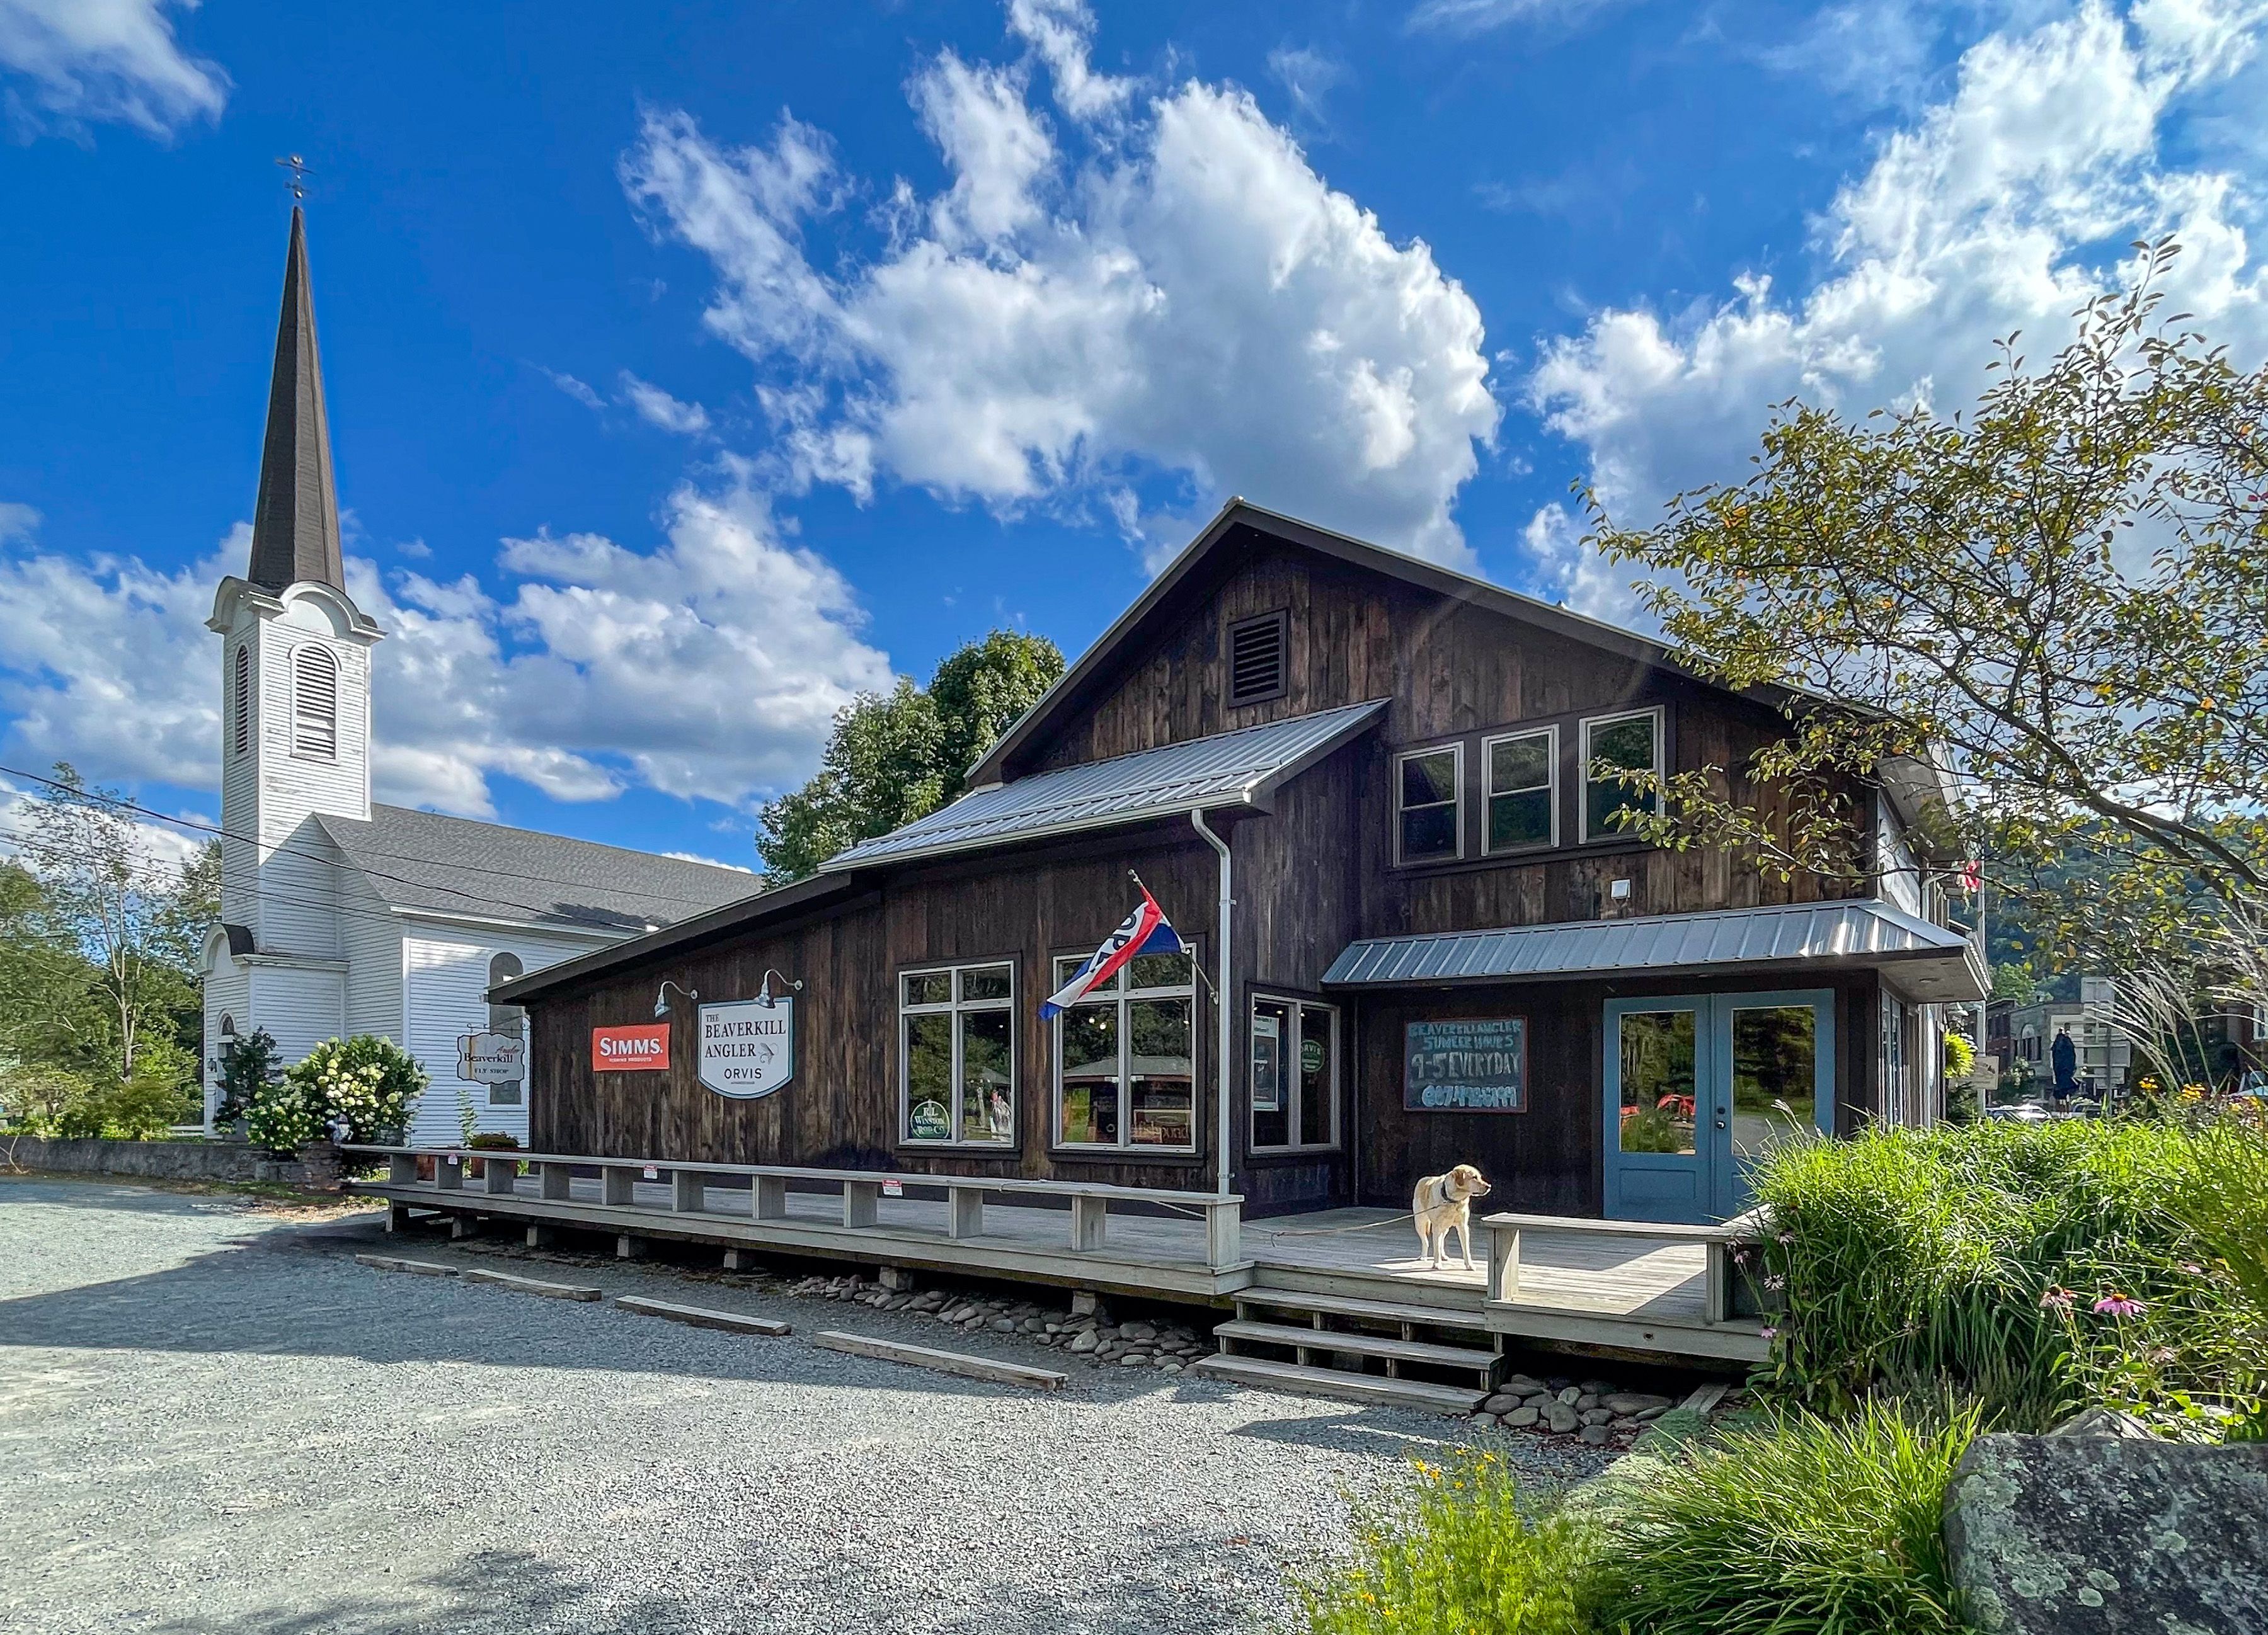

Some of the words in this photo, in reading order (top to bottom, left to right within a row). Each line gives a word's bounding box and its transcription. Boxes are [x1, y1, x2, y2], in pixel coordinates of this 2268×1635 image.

[706, 1014, 719, 1022] THE
[705, 1020, 786, 1039] BEAVERKILL
[705, 1043, 756, 1058] ANGLER
[464, 1052, 513, 1063] Beaverkill
[1411, 1053, 1447, 1079] 9-5
[724, 1068, 762, 1079] ORVIS
